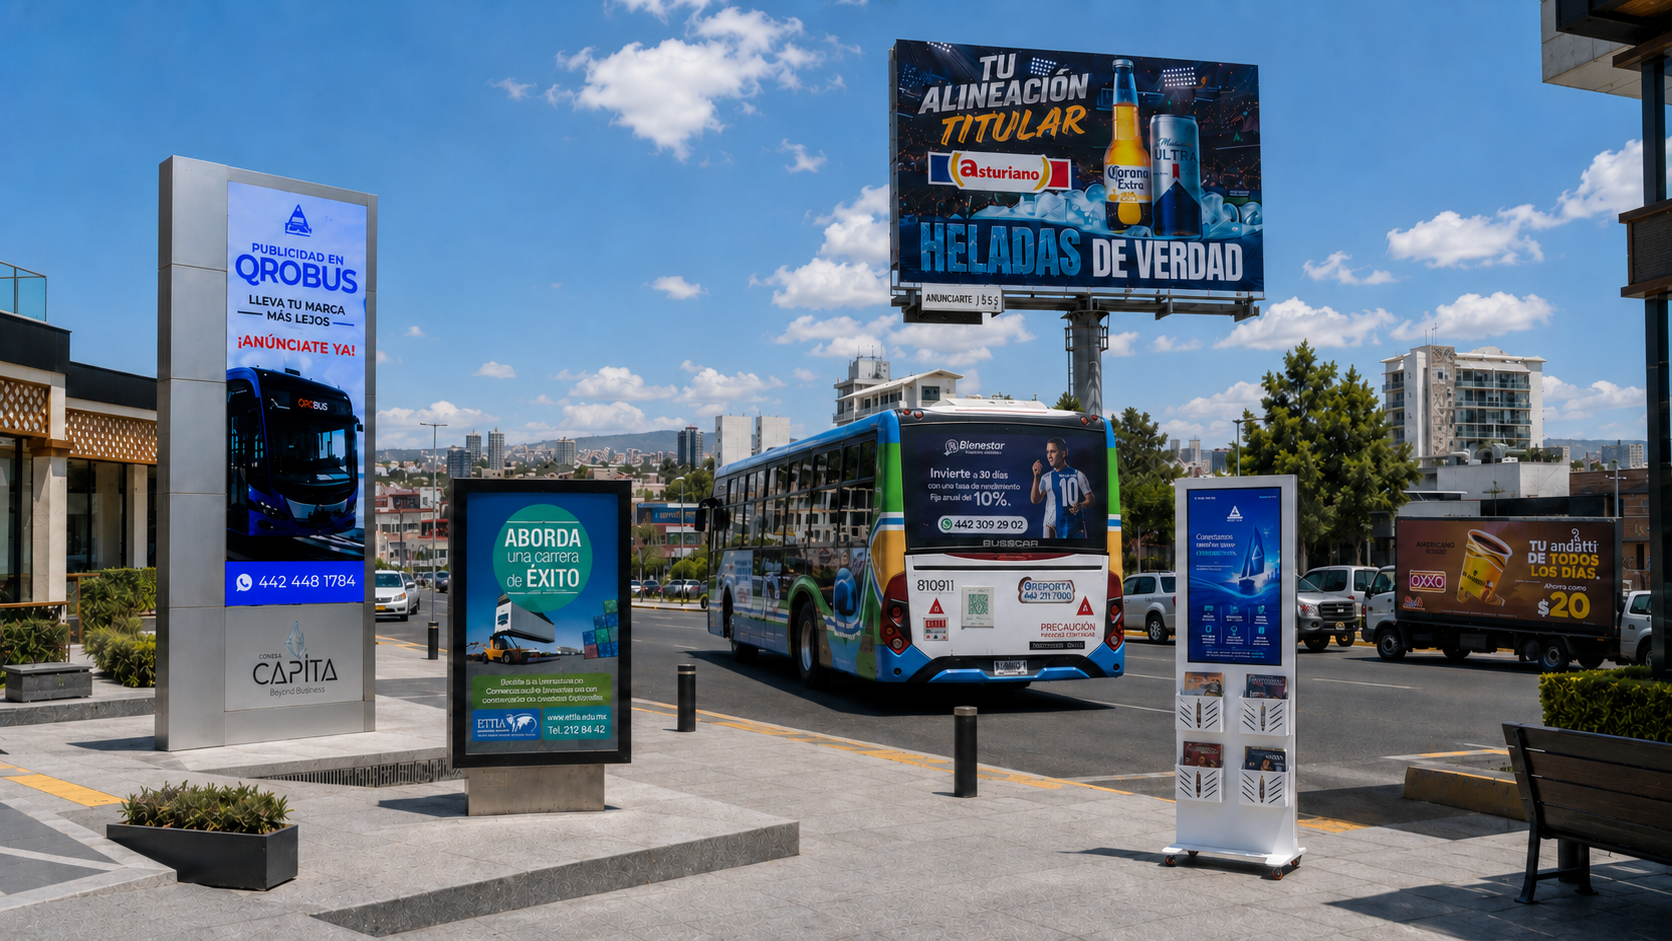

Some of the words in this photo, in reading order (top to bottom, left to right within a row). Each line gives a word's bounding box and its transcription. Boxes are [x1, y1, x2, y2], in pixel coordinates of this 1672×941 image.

[980, 53, 1016, 81] TU
[918, 68, 1089, 114] ALINEACIÓN
[941, 105, 1086, 146] TITULAR
[1154, 149, 1198, 164] ULTRA
[960, 158, 1040, 182] asturiano
[1118, 179, 1144, 190] Extra
[252, 242, 324, 262] PUBLICIDAD
[328, 254, 344, 266] EN
[920, 222, 1081, 278] HELADAS
[1092, 238, 1128, 278] DE
[1135, 240, 1243, 281] VERDAD
[235, 254, 358, 294] QROBUS
[249, 294, 285, 308] LLEVA
[288, 299, 302, 310] TU
[305, 302, 345, 315] MARCA
[926, 294, 972, 304] ANUNCIARTE
[267, 310, 292, 322] MÁS
[295, 314, 330, 327] LEJOS
[238, 334, 328, 354] ¡ANÚNCIATE
[332, 343, 355, 356] YA!
[930, 468, 971, 479] Invierte
[979, 470, 990, 479] 30
[992, 470, 1008, 479] días
[1060, 477, 1078, 507] 10
[955, 520, 973, 529] 442
[976, 520, 994, 529] 309
[997, 520, 1008, 529] 29
[1011, 520, 1023, 529] 02
[505, 528, 581, 547] ABORDA
[1529, 540, 1546, 551] TU
[508, 552, 531, 563] una
[535, 552, 579, 563] carrera
[1528, 553, 1546, 564] DE
[1549, 553, 1600, 566] TODOS
[507, 574, 522, 587] de
[527, 564, 579, 587] ÉXITO
[1531, 565, 1557, 577] LOS
[1562, 566, 1600, 580] DÍAS.
[259, 575, 287, 588] 442
[291, 575, 319, 588] 448
[324, 574, 356, 587] 1784
[917, 579, 954, 591] 810911
[1411, 574, 1444, 588] OXXO
[1538, 591, 1590, 619] $20
[1041, 621, 1096, 631] PRECAUCIÓN
[270, 688, 295, 698] Beyond
[296, 686, 325, 695] Business
[548, 726, 562, 734] Tel.
[564, 725, 579, 734] 212
[581, 725, 592, 734] 84
[594, 725, 605, 733] 42
